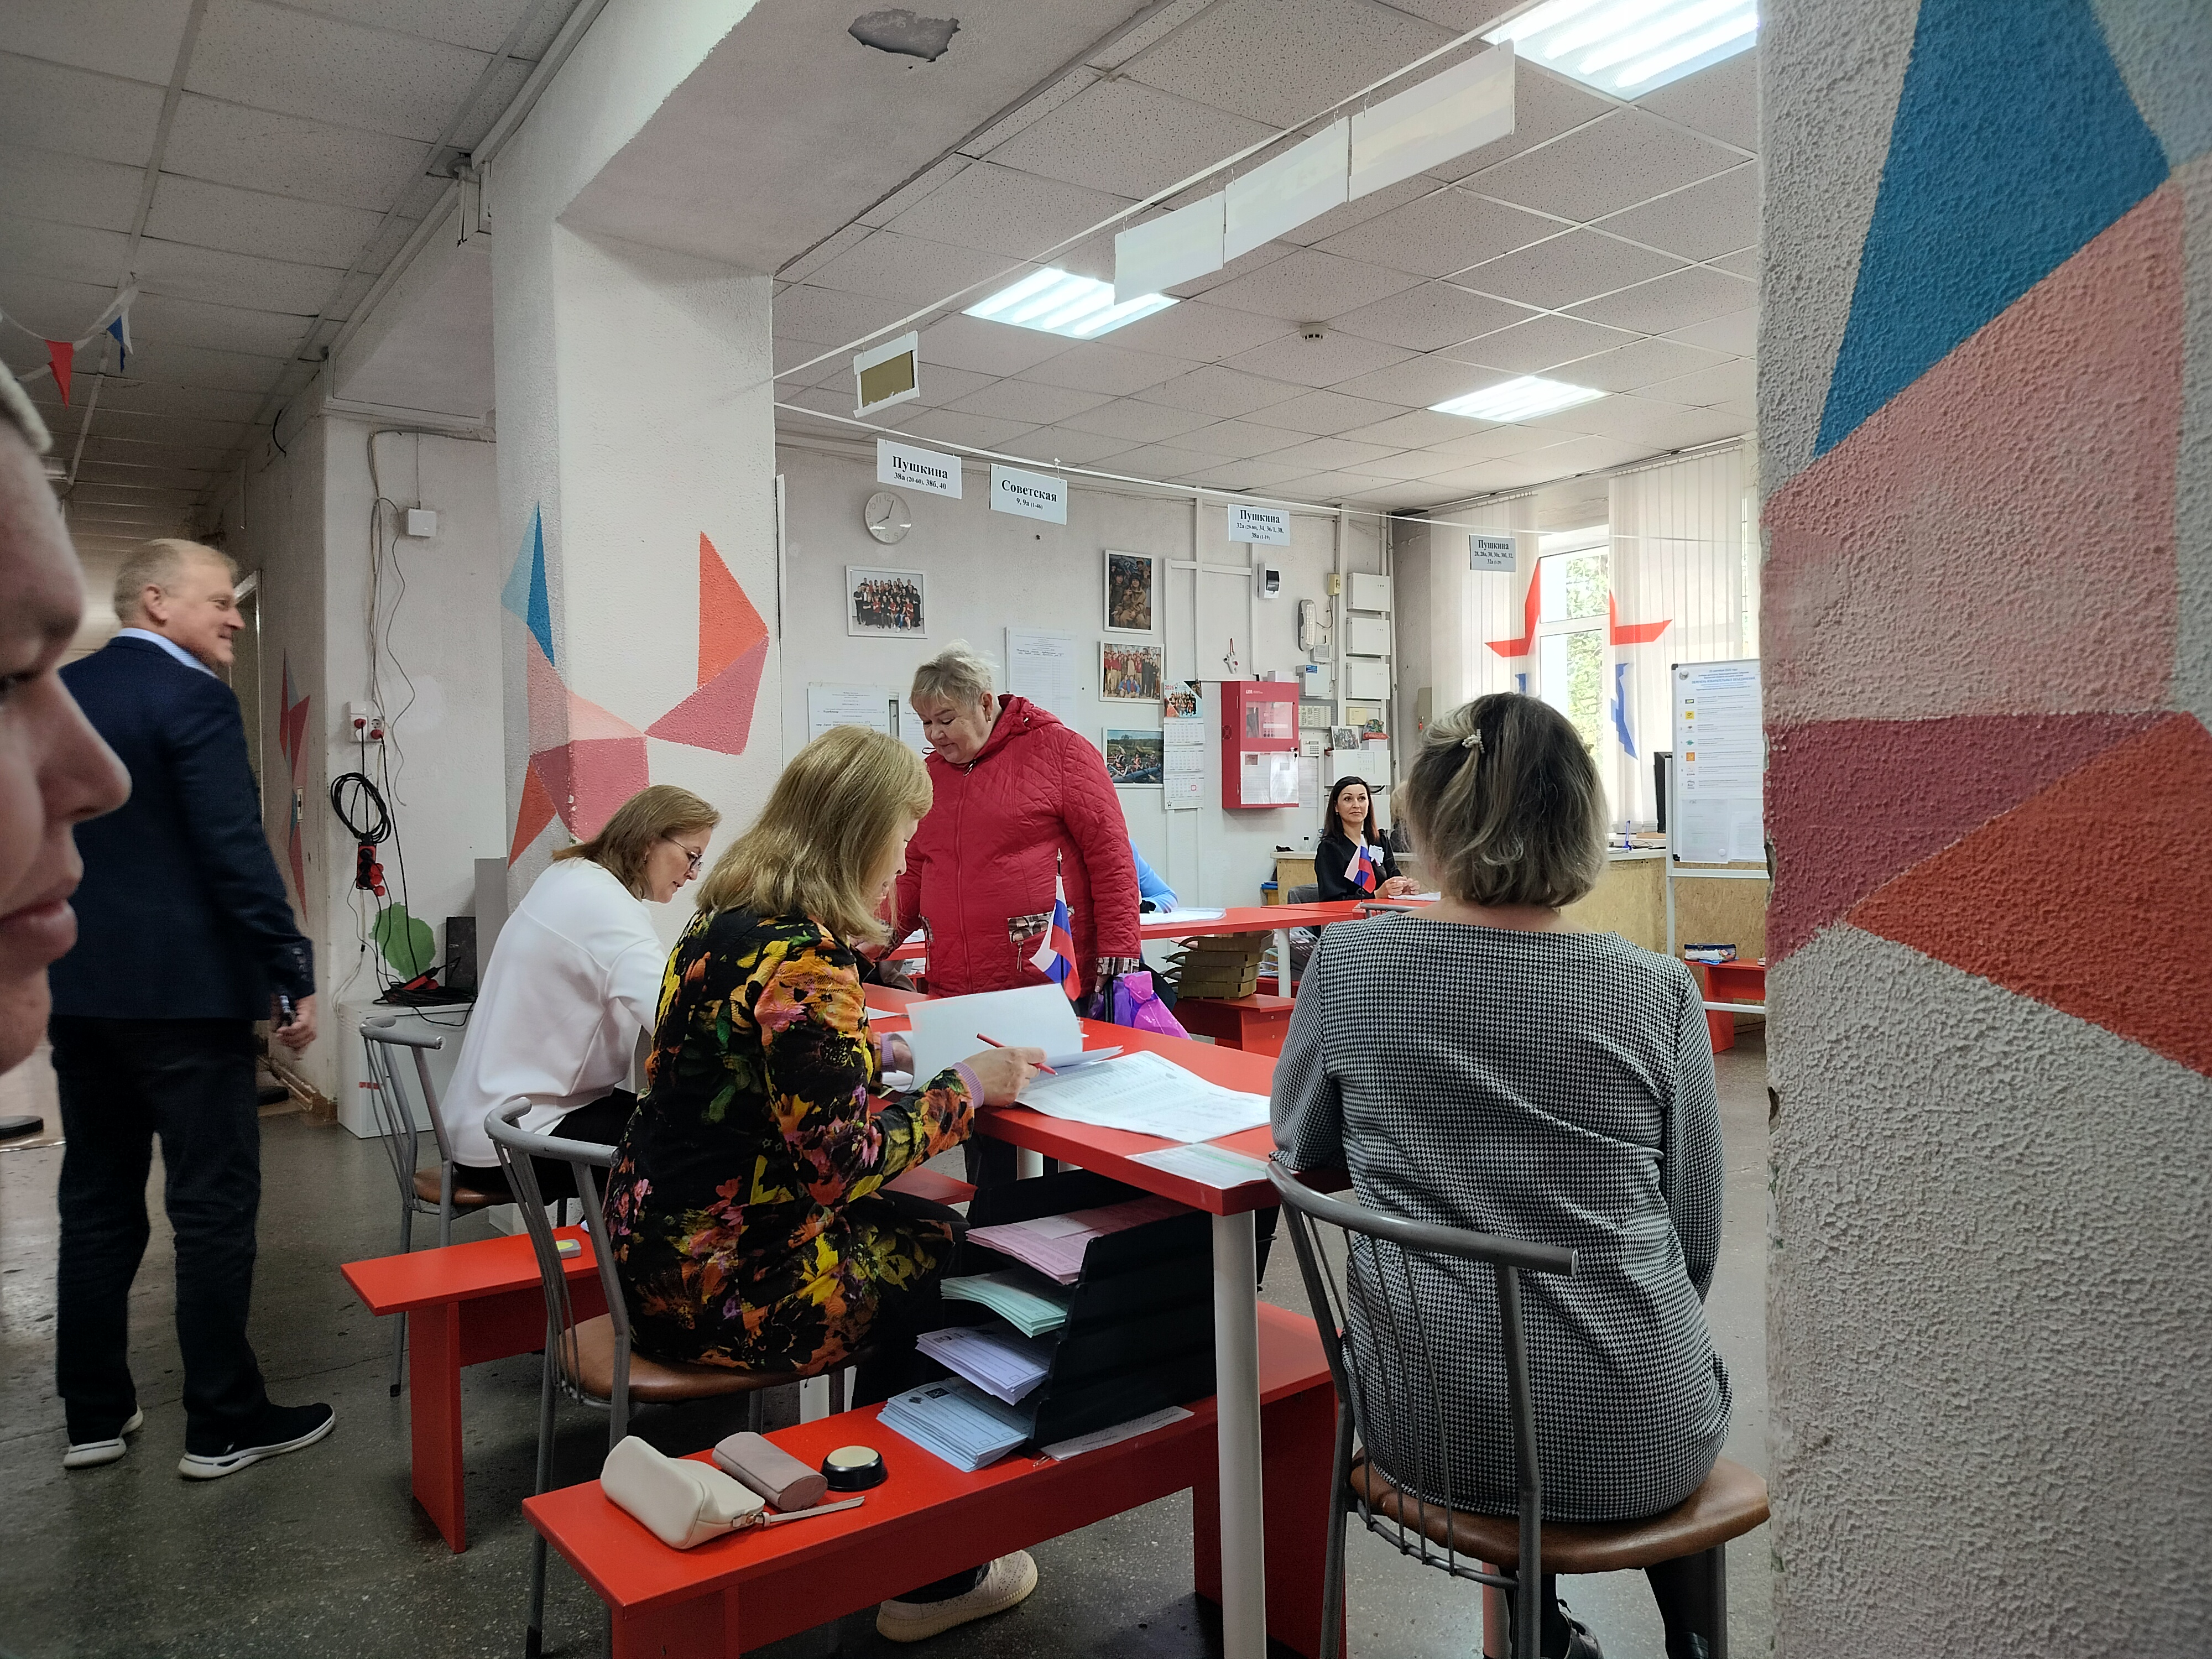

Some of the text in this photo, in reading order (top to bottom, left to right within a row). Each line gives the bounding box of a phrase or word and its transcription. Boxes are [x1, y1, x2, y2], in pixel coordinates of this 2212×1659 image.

[893, 456, 948, 479] Пушкина
[894, 472, 905, 481] 38а
[926, 479, 938, 488] 38б,
[884, 494, 891, 502] 12
[1001, 479, 1057, 502] Советская
[1240, 509, 1280, 523] Пушкина
[1478, 539, 1509, 551] Пушкина
